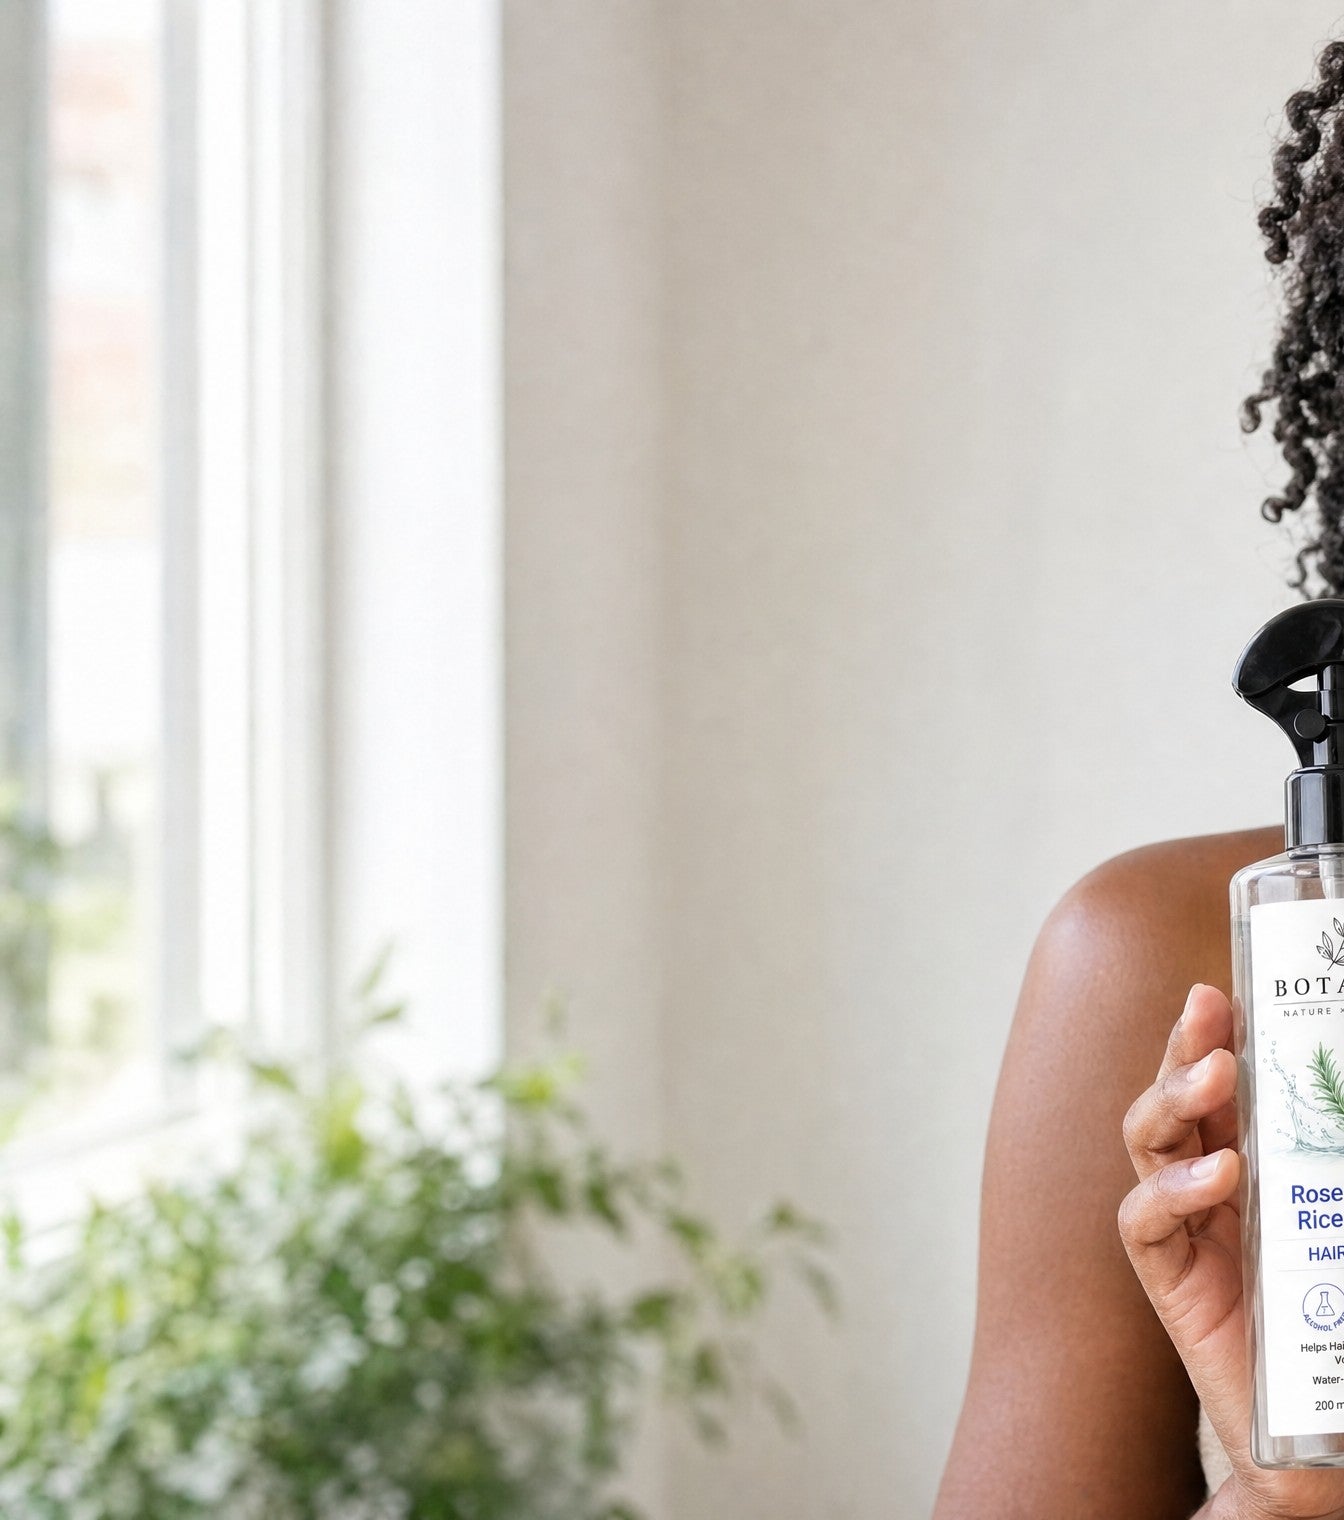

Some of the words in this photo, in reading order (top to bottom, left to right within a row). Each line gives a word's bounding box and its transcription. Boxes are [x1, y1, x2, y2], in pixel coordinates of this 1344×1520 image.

[1283, 1007, 1332, 1017] NATURE
[1298, 1209, 1344, 1230] Rice
[1300, 1342, 1327, 1354] Helps
[1315, 1400, 1334, 1411] 200
